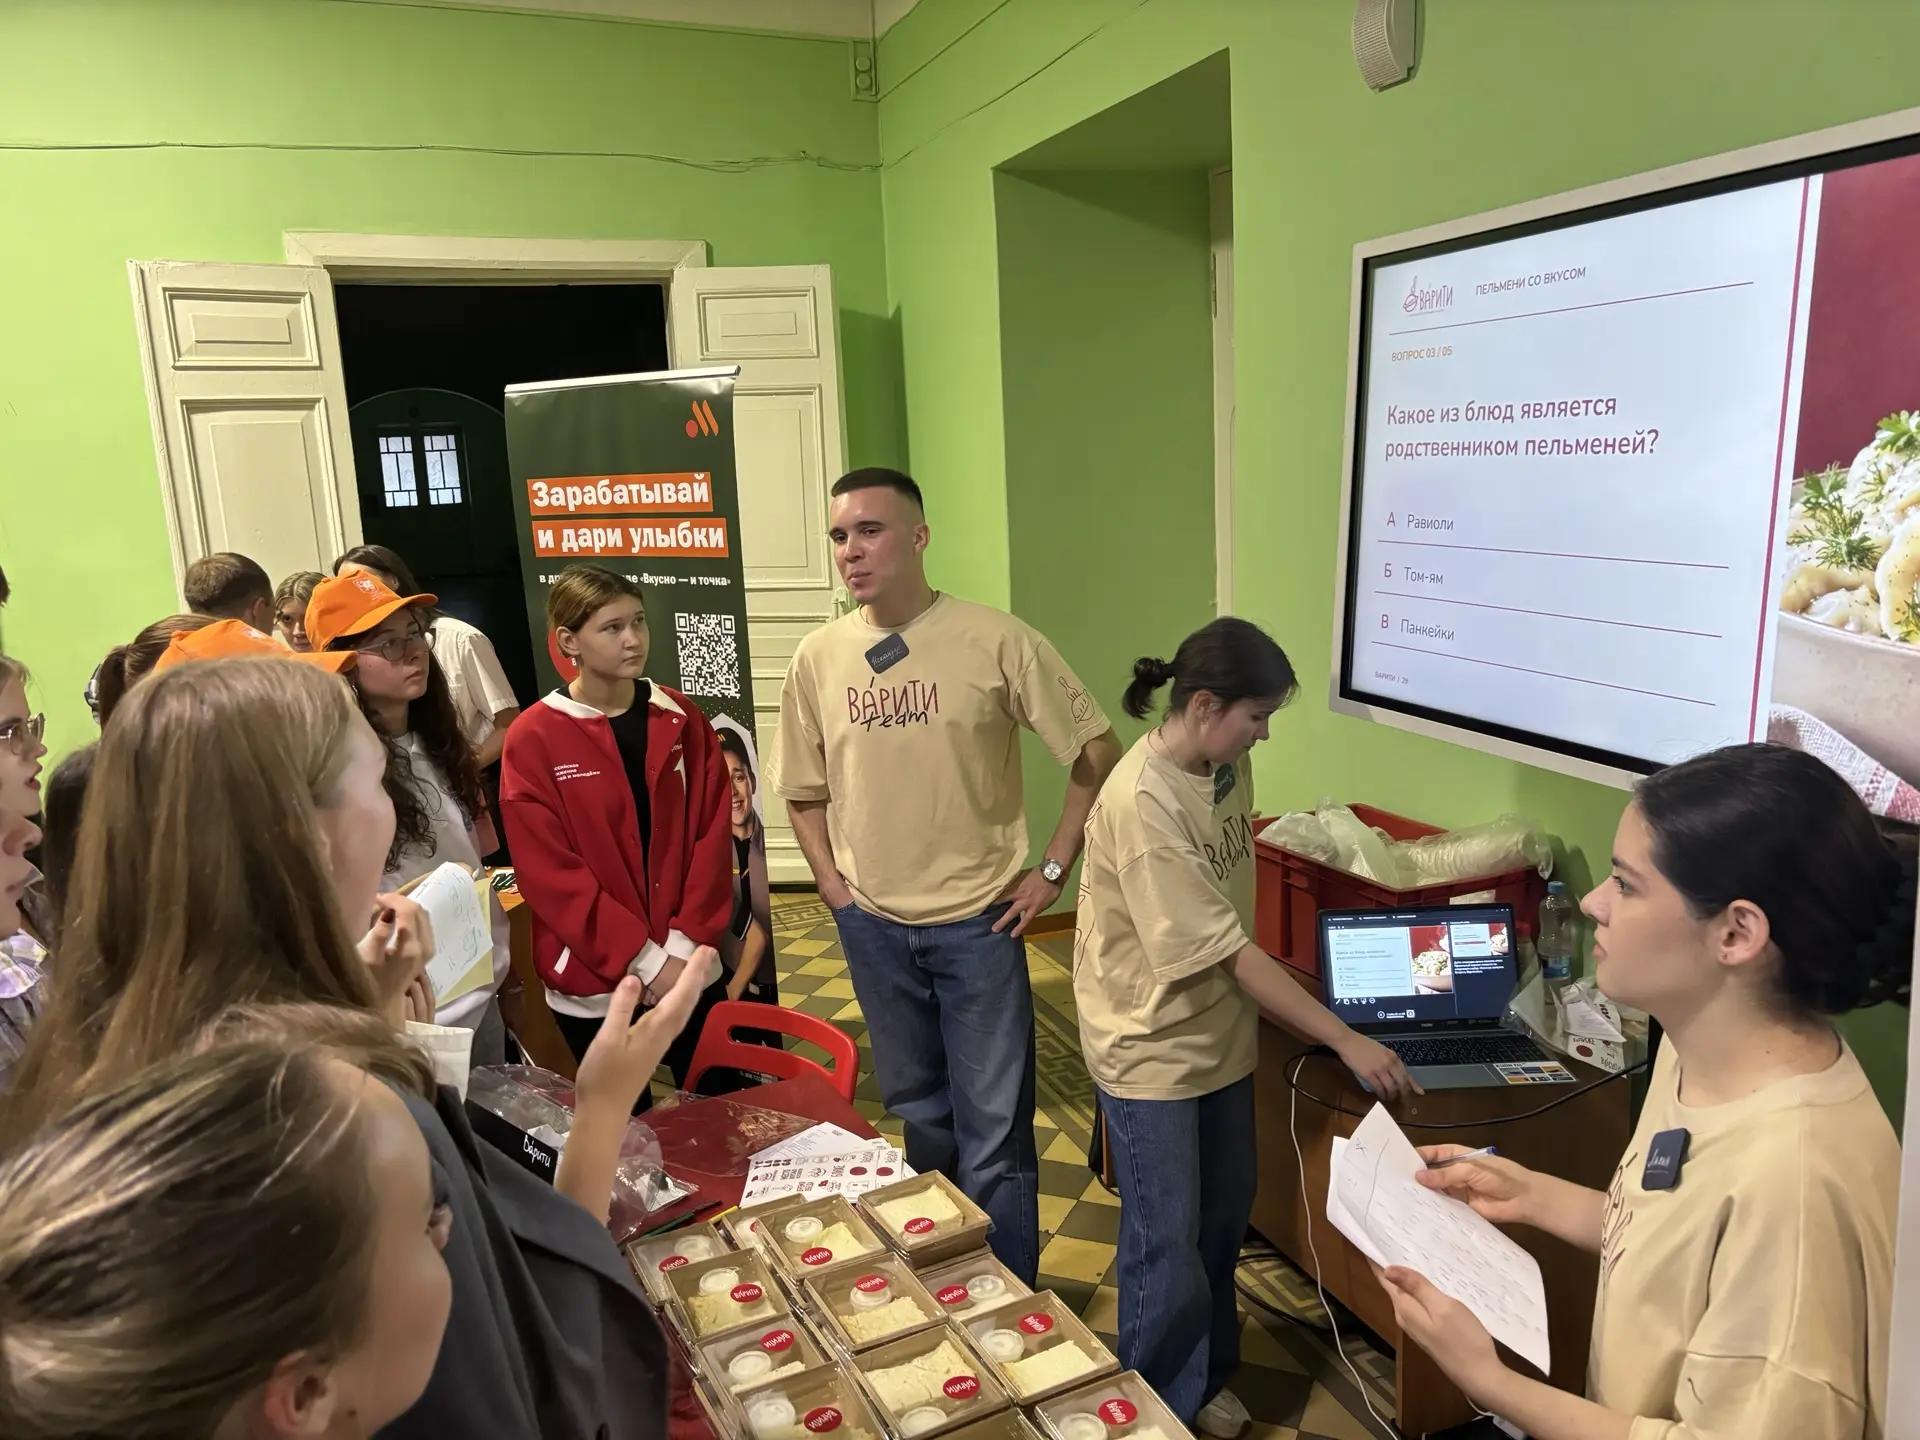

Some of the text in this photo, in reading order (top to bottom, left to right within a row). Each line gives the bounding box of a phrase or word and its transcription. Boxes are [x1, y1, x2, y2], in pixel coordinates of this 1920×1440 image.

[1475, 266, 1587, 296] ПЕЛЬМЕНИ СО ВКУСОМ
[1391, 349, 1425, 362] ВОПРОС
[1426, 347, 1436, 358] 03
[1442, 345, 1453, 357] 05
[1386, 397, 1618, 425] Какое из блюд является
[1385, 428, 1660, 461] родственником пельменей?
[531, 472, 709, 511] Зарабатывай
[1386, 511, 1455, 532] А Равиоли
[537, 522, 725, 554] и дари улыбки
[539, 574, 546, 584] в
[640, 572, 677, 587] «Вкусно
[690, 576, 697, 585] и
[698, 576, 732, 587] точка»
[1383, 562, 1445, 585] Б Том-ям
[1380, 613, 1456, 641] В Панкейки
[860, 709, 929, 732] team
